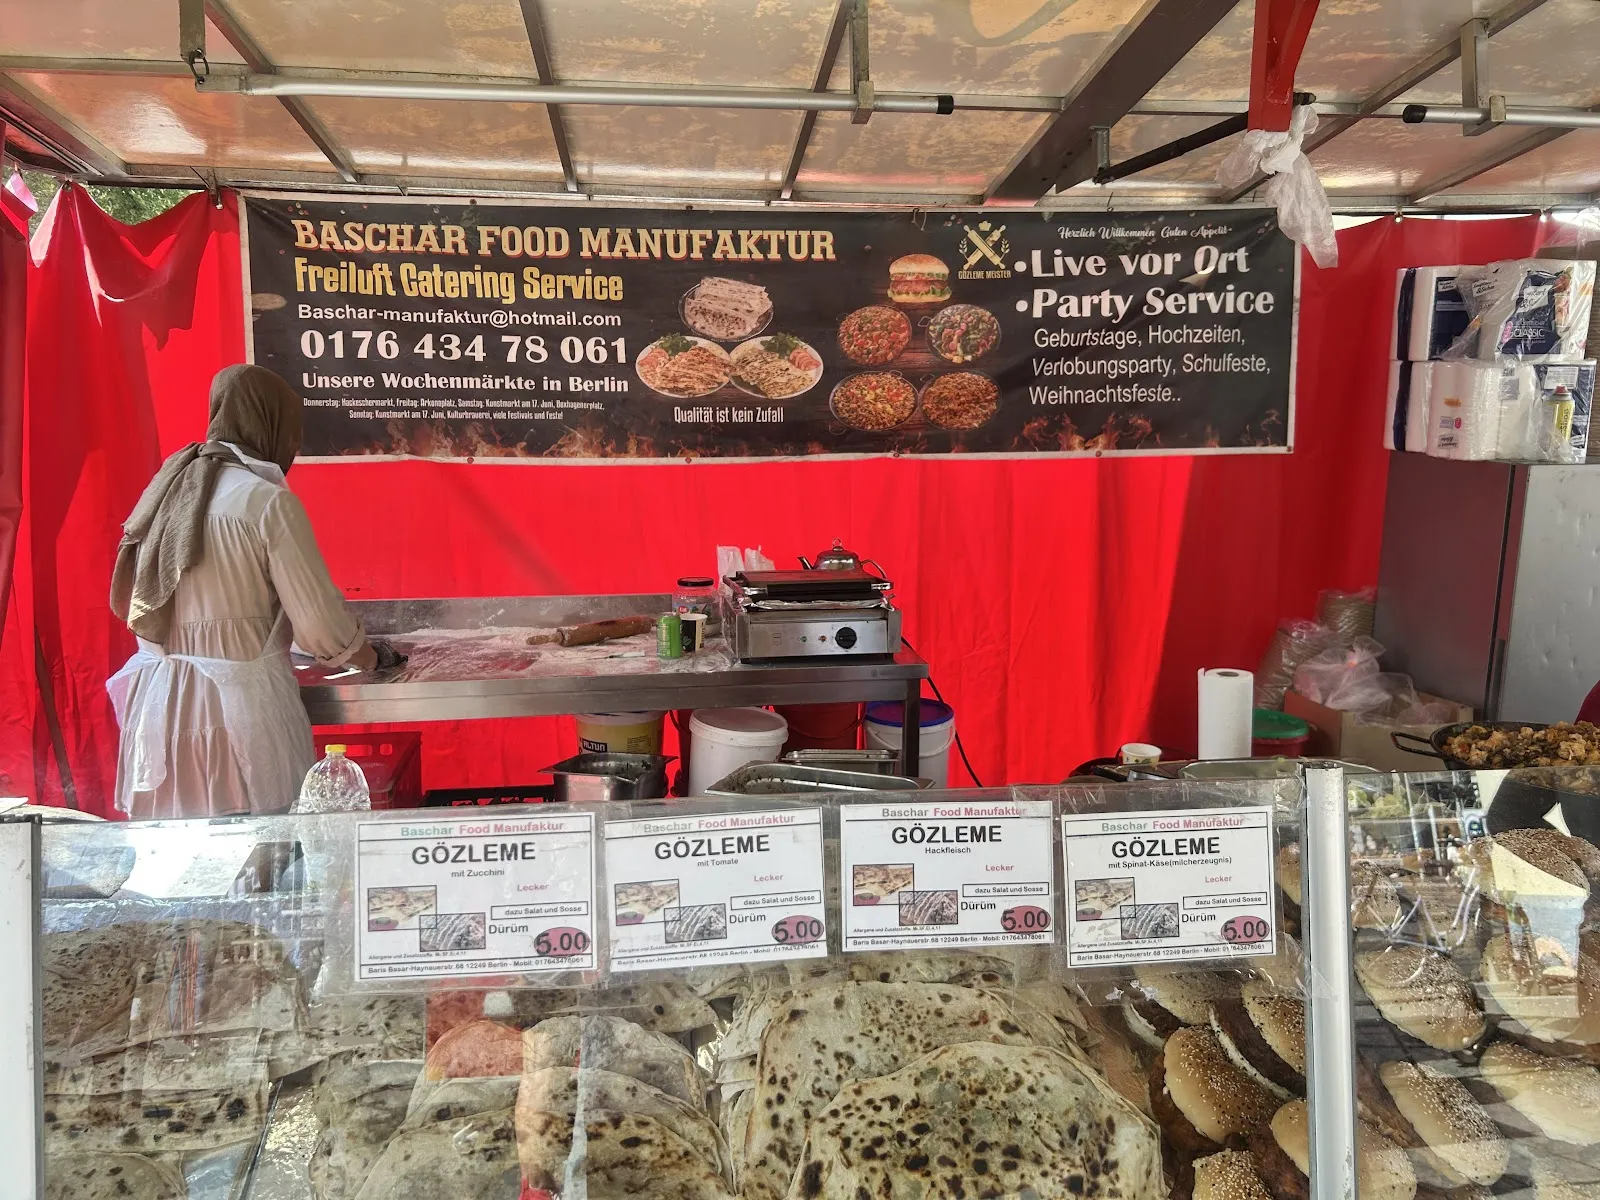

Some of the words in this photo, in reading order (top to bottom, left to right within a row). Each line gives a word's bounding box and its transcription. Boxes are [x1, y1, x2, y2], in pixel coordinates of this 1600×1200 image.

[292, 219, 468, 255] BASCHAR
[477, 226, 569, 258] FOOD
[579, 227, 836, 261] MANUFAKTUR
[1058, 227, 1095, 238] Herzlich
[1098, 227, 1155, 240] Willkommen
[1161, 226, 1187, 238] Guten
[1032, 249, 1107, 278] Live
[1120, 252, 1181, 276] vor
[1194, 245, 1250, 275] Ort
[295, 257, 395, 296] Freiluft
[400, 262, 515, 305] Catering
[523, 266, 623, 301] Service
[986, 270, 1011, 278] MEISTER
[1032, 288, 1133, 324] Party
[1143, 285, 1274, 316] Service
[298, 304, 621, 328] Baschar-manufaktur@hotmail.com
[301, 330, 399, 360] 0176
[414, 333, 486, 361] 434
[501, 335, 548, 363] 78
[561, 337, 627, 363] 061
[1034, 327, 1142, 349] Geburtstage,
[1148, 326, 1245, 346] Hochzeiten,
[1032, 356, 1176, 379] Verlobungsparty,
[1182, 353, 1271, 374] Schulfeste,
[302, 373, 375, 389] Unsere
[382, 373, 535, 391] Wochenmärkte
[543, 376, 561, 391] in
[569, 376, 628, 392] Berlin
[674, 406, 714, 424] Qualität
[716, 407, 729, 423] ist
[732, 406, 753, 423] kein
[756, 406, 784, 423] Zufall
[882, 808, 929, 817] Baschar
[934, 808, 961, 816] Food
[964, 807, 1027, 816] Manufaktur
[400, 826, 454, 837] Baschar
[459, 824, 490, 834] Food
[494, 821, 564, 832] Manufaktur
[643, 821, 692, 833] Baschar
[698, 818, 726, 829] Food
[731, 814, 795, 827] Manufaktur
[1102, 821, 1147, 832] Baschar
[1153, 821, 1180, 830] Food
[1183, 817, 1244, 828] Manufaktur
[892, 823, 1002, 844] GÖZLEME
[412, 842, 536, 864] GÖZLEME
[655, 834, 770, 859] GÖZLEME
[925, 846, 971, 854] Hackfleisch
[1112, 836, 1220, 858] GÖZLEME
[697, 859, 709, 867] mit
[711, 858, 738, 866] Tomate
[986, 864, 1014, 872] Lecker
[1122, 856, 1232, 869] Spinat-Käse(milcherzeugnis)
[451, 869, 465, 878] mit
[467, 868, 504, 877] Zucchini
[754, 874, 783, 882] Lecker
[517, 883, 549, 892] Lecker
[504, 908, 522, 916] dazu
[525, 906, 543, 914] Salat
[961, 901, 996, 911] Dürüm
[1196, 898, 1211, 906] dazu
[730, 912, 766, 923] Dürüm
[1002, 910, 1049, 930] 5.00
[1182, 912, 1216, 923] Dürüm
[489, 924, 528, 934] Dürüm
[774, 920, 822, 944] 5.00
[1222, 920, 1268, 941] 5.00
[535, 931, 589, 955] 5.00
